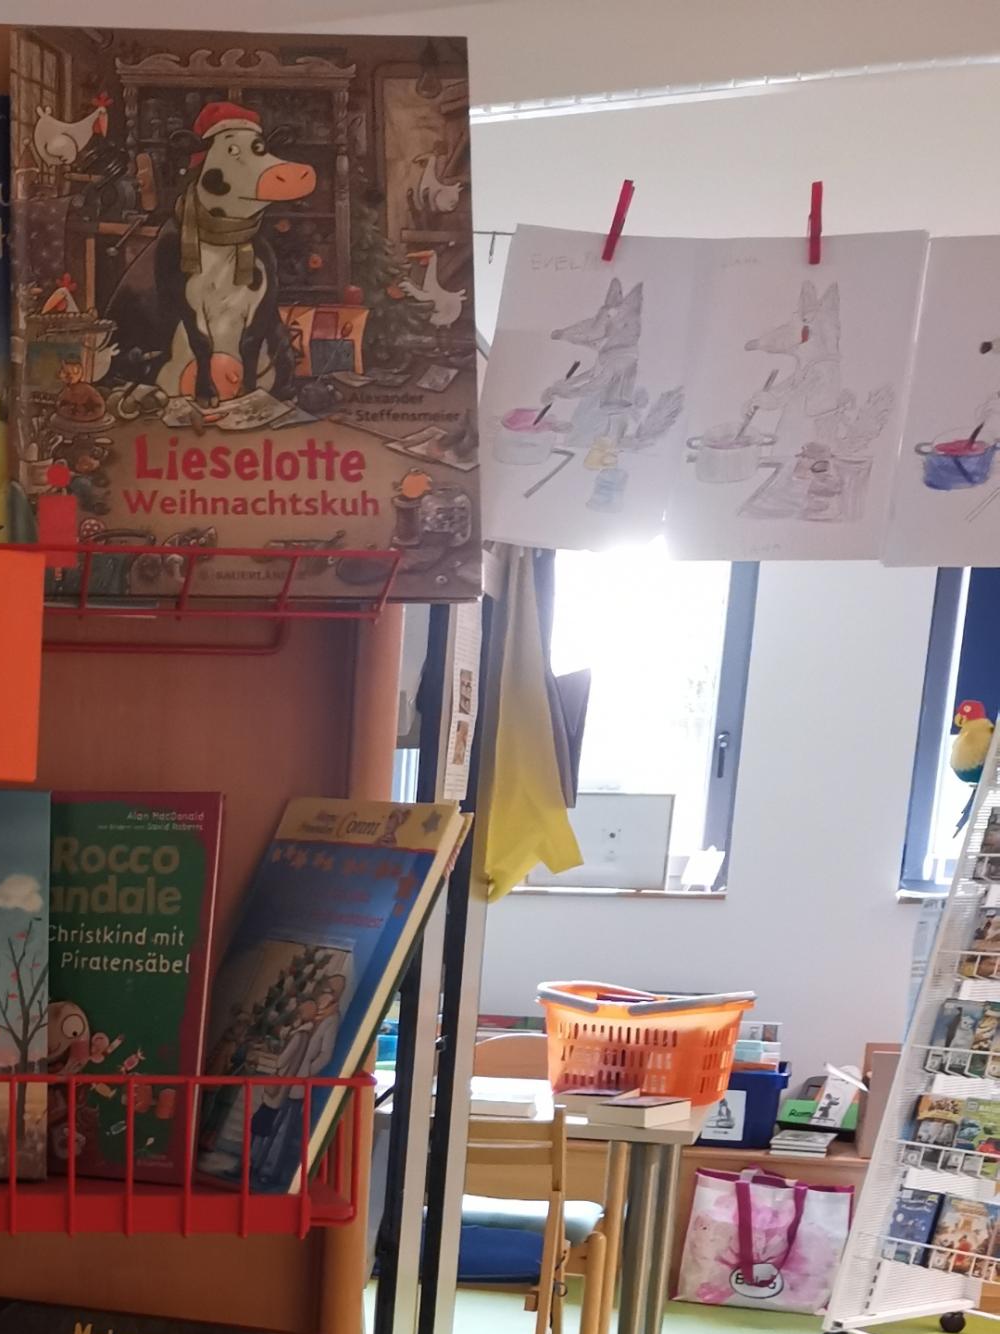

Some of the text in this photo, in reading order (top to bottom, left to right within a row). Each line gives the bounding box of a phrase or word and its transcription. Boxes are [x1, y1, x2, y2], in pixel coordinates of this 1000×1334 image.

[135, 433, 367, 483] Lieselotte
[122, 488, 381, 518] Weihnachtskuh
[53, 837, 181, 875] Rocco
[47, 924, 185, 947] Christkind mit
[61, 950, 191, 975] Piratensäbel
